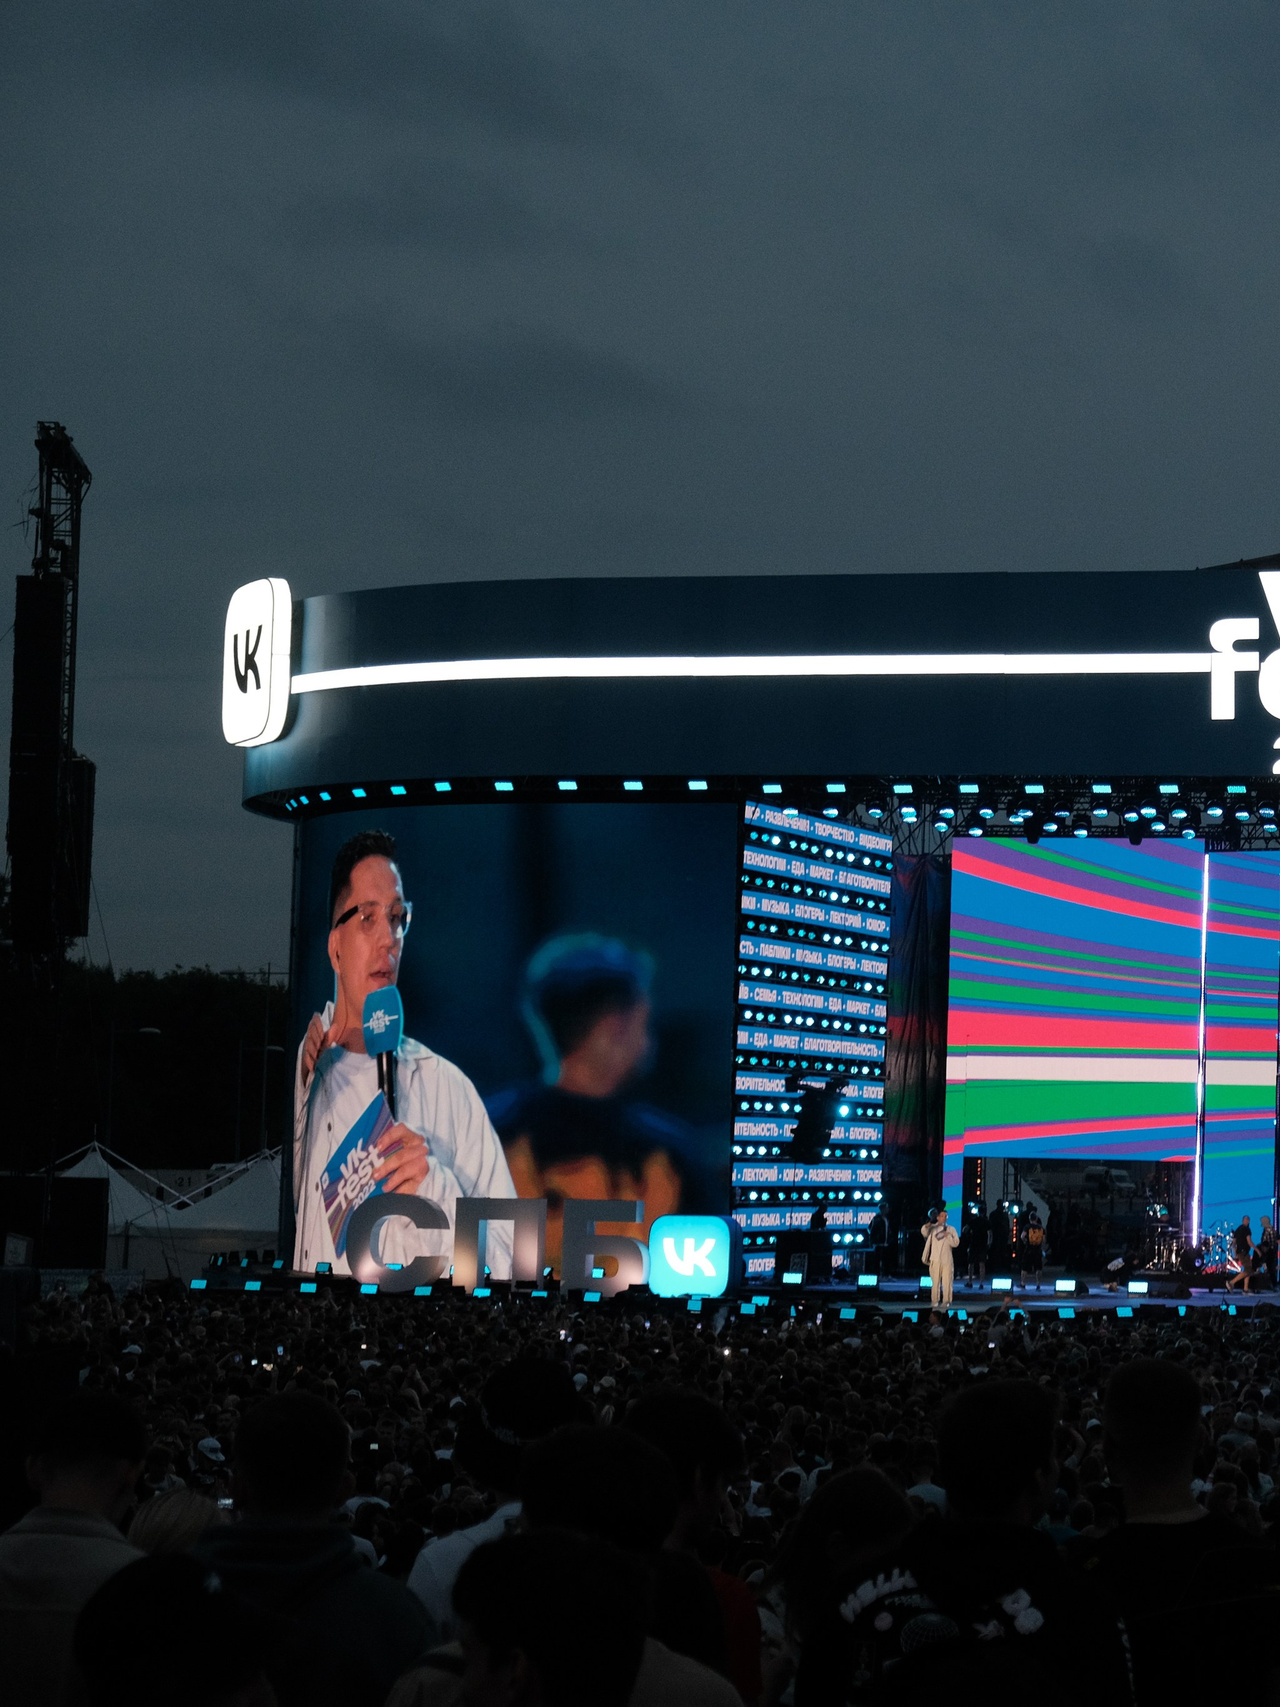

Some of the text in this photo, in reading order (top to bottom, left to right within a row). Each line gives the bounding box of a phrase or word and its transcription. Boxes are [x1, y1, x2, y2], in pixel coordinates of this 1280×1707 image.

[233, 624, 263, 694] VK
[814, 822, 855, 843] ТВОРЧЕСТВО
[791, 860, 805, 877] ЕДА
[809, 865, 835, 882] МАРКЕТ
[761, 898, 790, 915] МУЗЫКА
[794, 904, 825, 922] БЛОГЕРЫ
[829, 910, 862, 928] ЛЕКТОРИЙ
[866, 917, 886, 932] ЮМОР
[760, 943, 791, 960] ПАБЛИКИ
[795, 948, 823, 965] МУЗЫКА
[827, 954, 857, 970] БЛОГЕРЫ
[754, 987, 777, 1003] СЕМЬЯ
[782, 991, 824, 1009] ТЕХНОЛОГИИ
[828, 997, 842, 1013] ЕДА
[846, 1000, 871, 1015] МАРКЕТ
[753, 1032, 768, 1049] ЕДА
[773, 1034, 800, 1049] МАРКЕТ
[804, 1037, 878, 1057] БЛАГОТВОРИТЕЛЬНОСТЬ
[849, 1126, 878, 1141] БЛОГЕРЫ
[340, 1138, 368, 1180] VK
[338, 1144, 385, 1210] fest
[742, 1165, 778, 1182] ЛЕКТОРИЙ
[783, 1168, 804, 1182] ЮМОР
[808, 1168, 852, 1182] РАЗВЛЕЧЕНИЯ
[752, 1213, 781, 1227] МУЗЫКА
[346, 1192, 650, 1298] СПБ
[663, 1237, 717, 1277] VK
